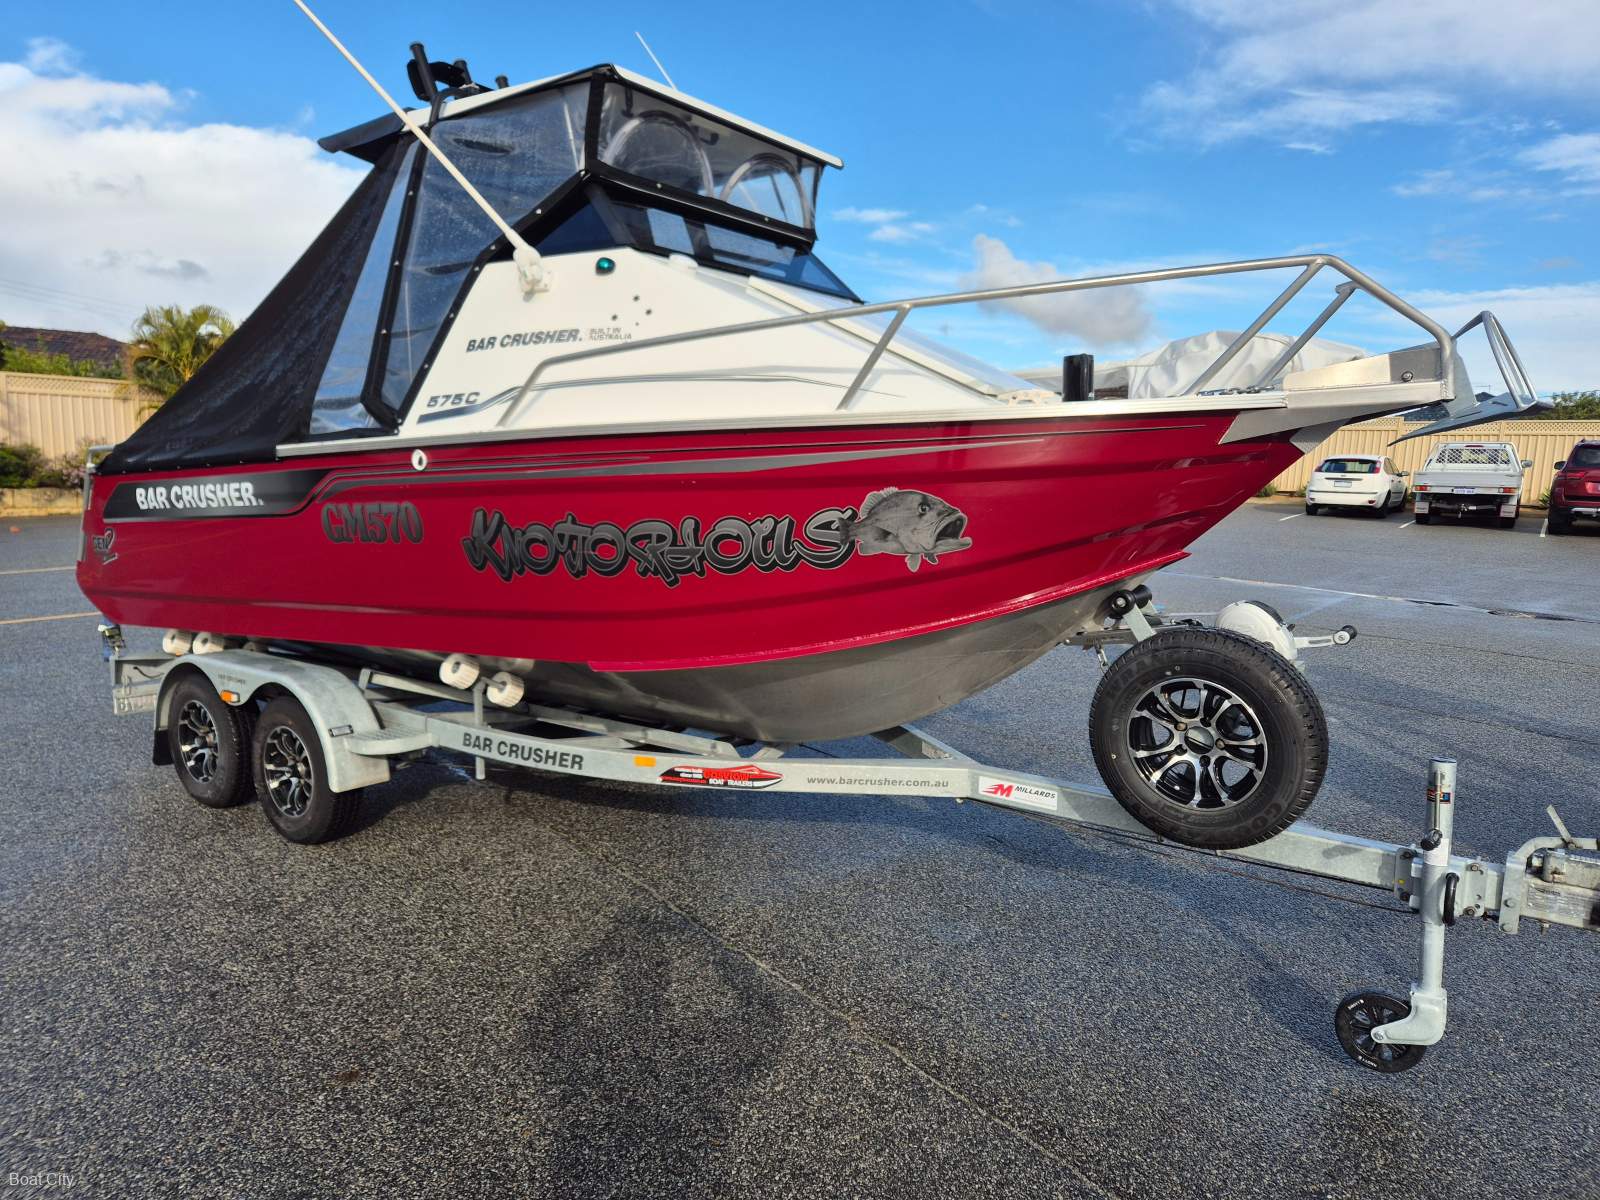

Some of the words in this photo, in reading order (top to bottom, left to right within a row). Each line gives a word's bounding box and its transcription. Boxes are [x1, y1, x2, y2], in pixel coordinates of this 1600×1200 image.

[466, 336, 497, 352] BAR
[590, 333, 632, 341] AUSTRALIA
[427, 392, 480, 407] 575C
[135, 487, 170, 510] BAR
[321, 501, 424, 544] GM570
[462, 732, 493, 753] BAR
[497, 740, 584, 770] CRUSHER
[807, 776, 949, 788] www.barcrusher.com.au
[1015, 785, 1056, 799] MILLARDS
